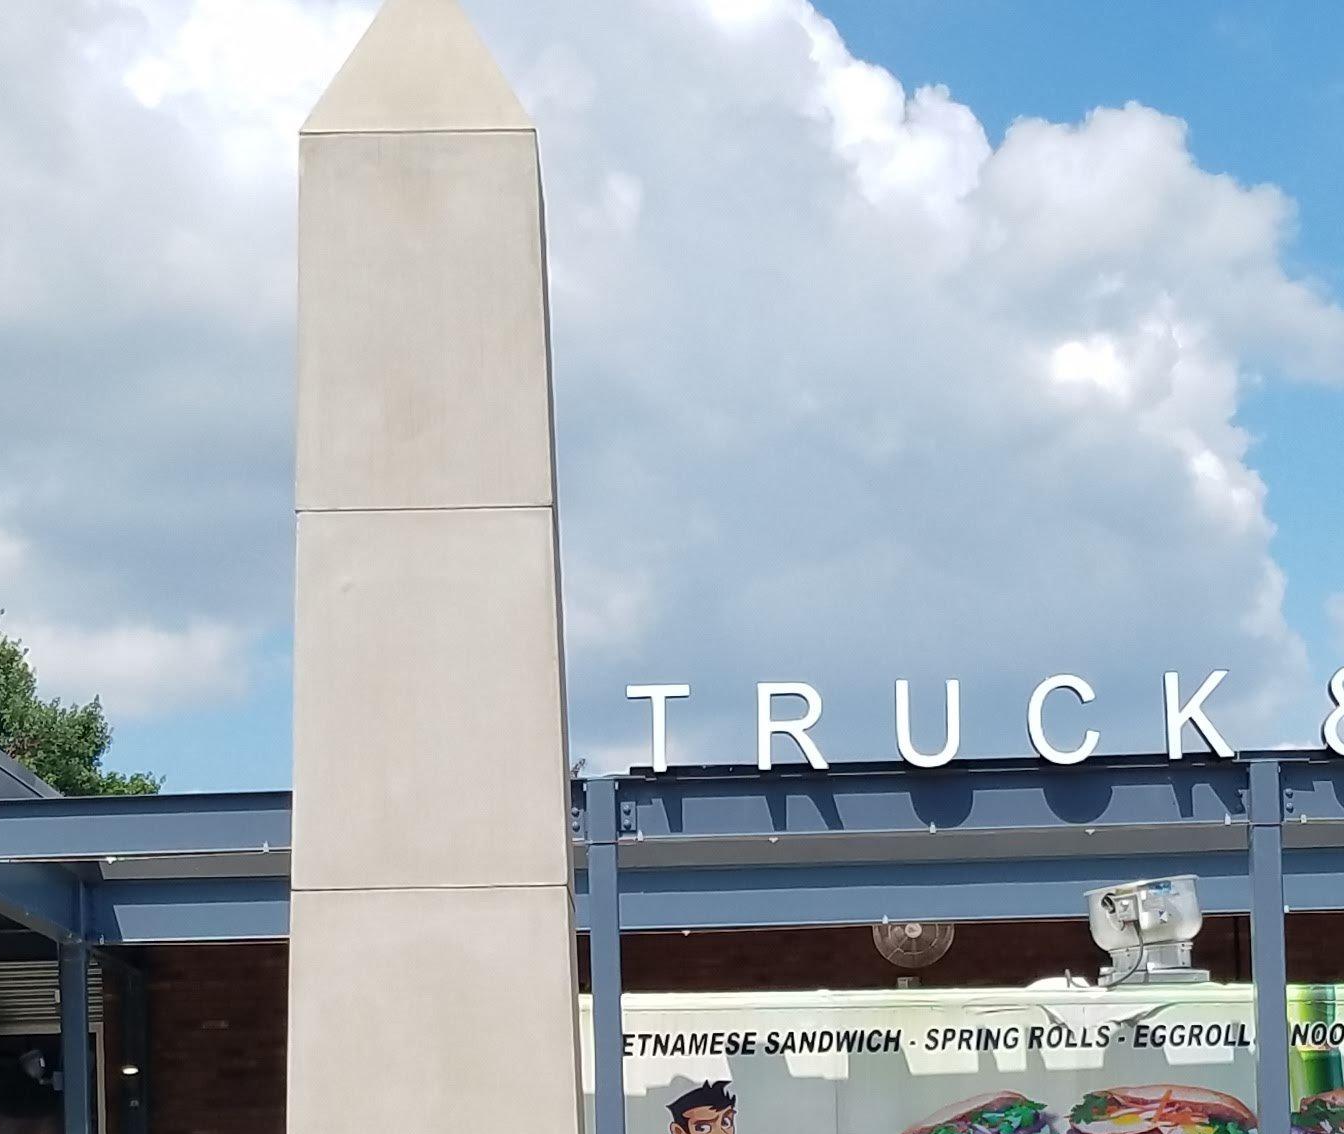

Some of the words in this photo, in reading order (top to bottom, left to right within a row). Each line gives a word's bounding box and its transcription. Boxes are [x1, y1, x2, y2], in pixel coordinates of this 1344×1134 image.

[626, 669, 1236, 773] TRUCK
[622, 1032, 757, 1057] ETNAMESE
[764, 1029, 902, 1055] SANDWICH
[924, 1026, 1020, 1052] SPRING
[1028, 1024, 1111, 1050] ROLLS
[1132, 1023, 1256, 1049] EGGROLL
